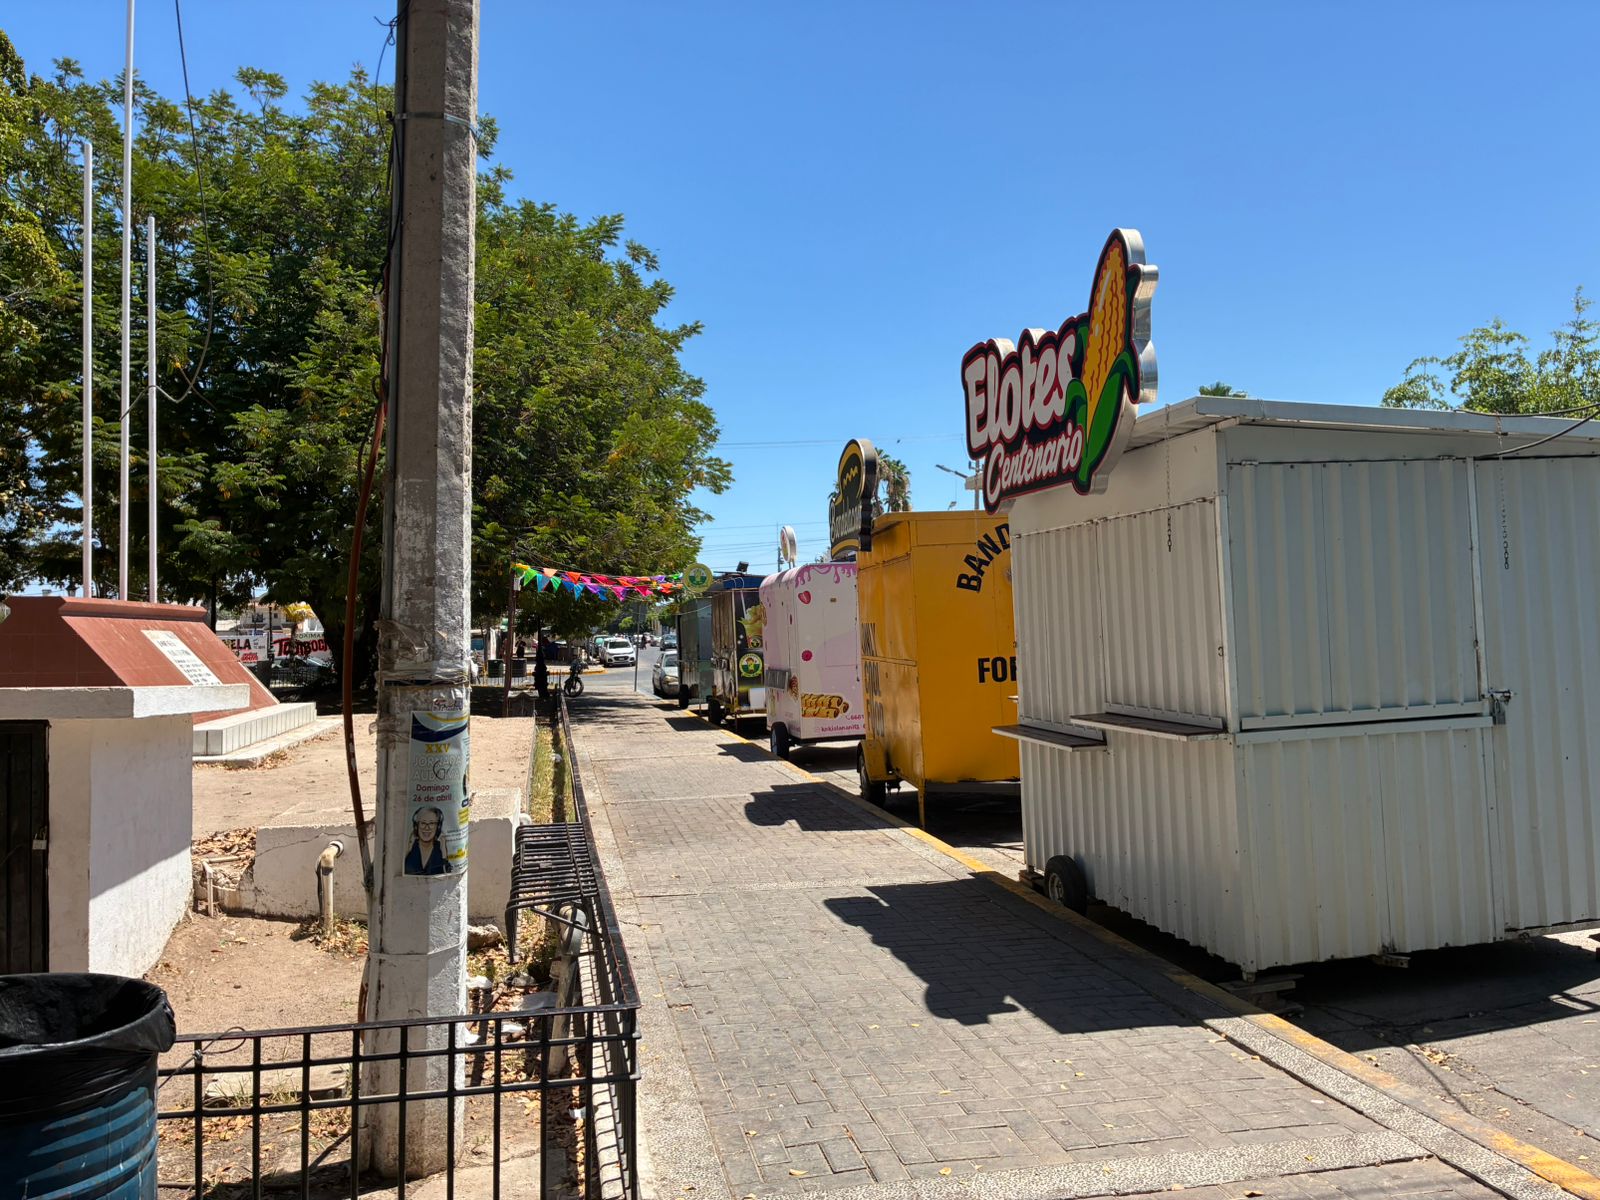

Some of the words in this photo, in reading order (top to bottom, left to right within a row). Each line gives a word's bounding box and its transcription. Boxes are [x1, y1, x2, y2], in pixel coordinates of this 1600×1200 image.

[965, 334, 1076, 450] Elotes
[986, 422, 1083, 504] Centenario
[425, 743, 450, 753] XXV
[416, 784, 450, 792] Domingo
[412, 794, 422, 802] 26
[436, 793, 452, 802] abril
